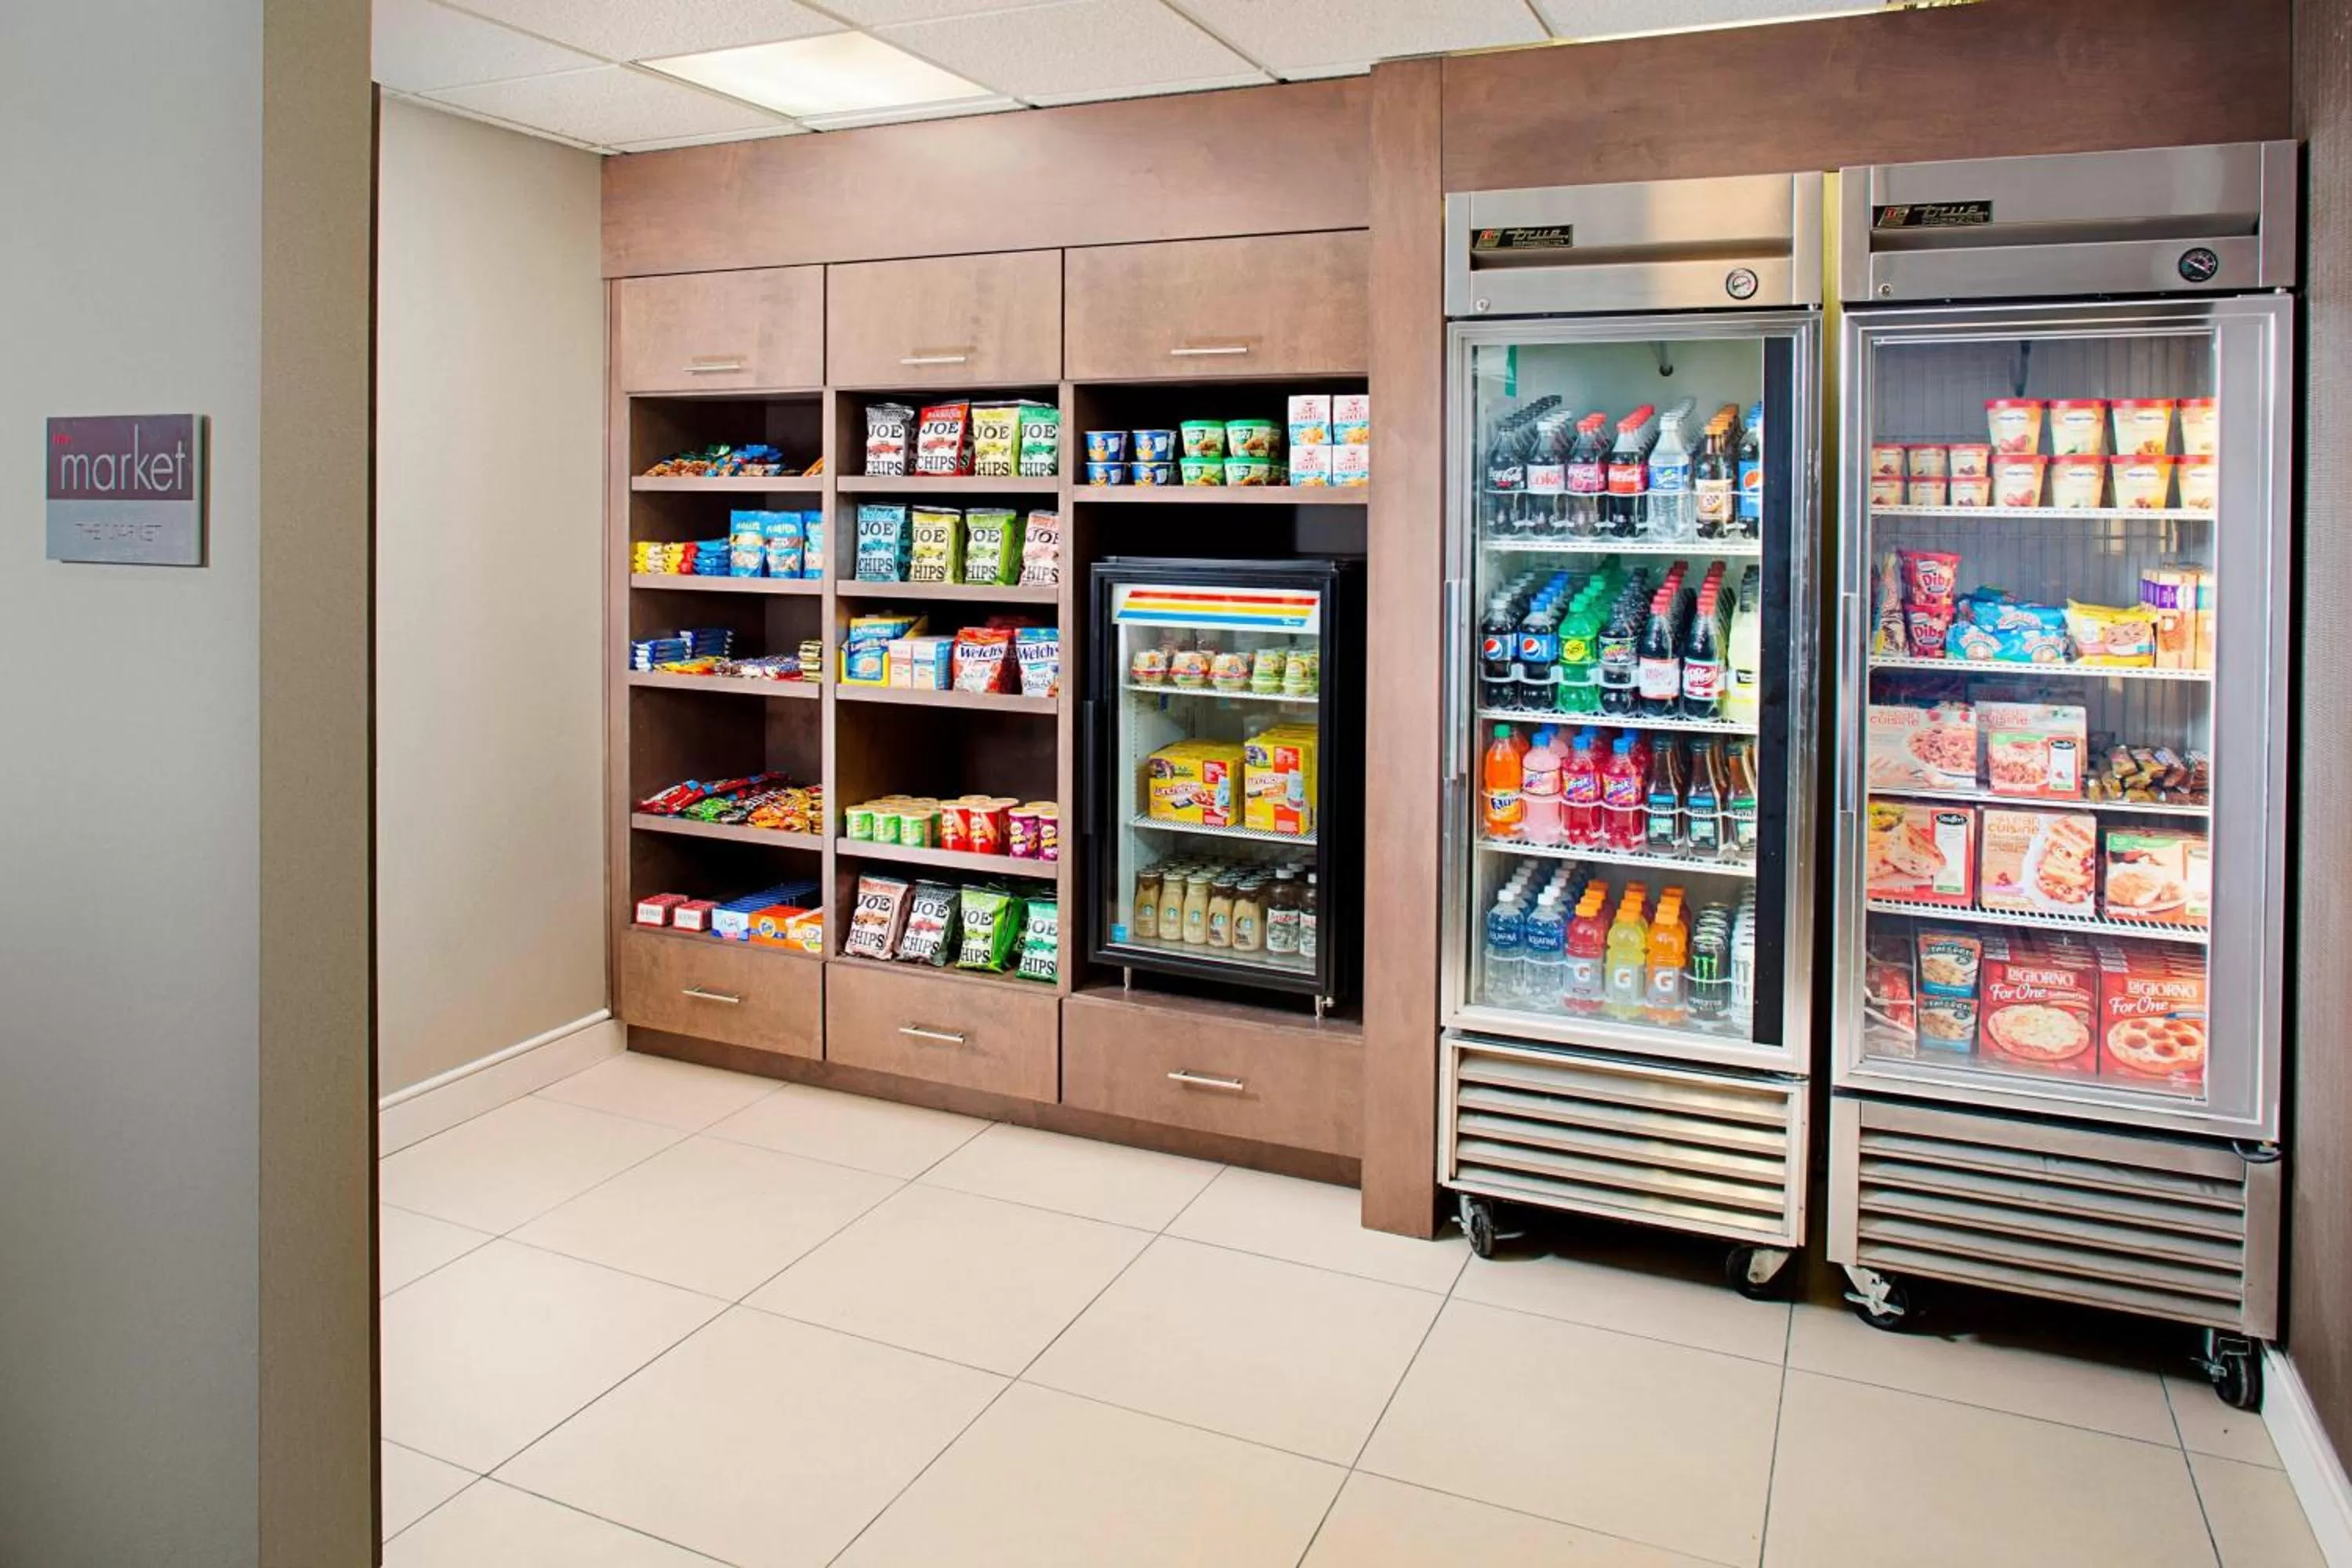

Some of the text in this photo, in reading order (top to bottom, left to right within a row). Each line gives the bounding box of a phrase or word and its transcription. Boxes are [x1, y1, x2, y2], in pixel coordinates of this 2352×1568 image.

[869, 424, 902, 438] JOE
[923, 421, 959, 434] JOE
[975, 425, 1010, 440] JOE
[1022, 424, 1056, 438] JOE
[60, 423, 186, 492] market
[916, 456, 956, 470] CHIPS
[975, 462, 1009, 476] HIPS
[860, 522, 894, 535] JOE
[913, 529, 946, 543] JOE
[973, 529, 1000, 543] OE
[858, 557, 893, 572] CHIPS
[913, 565, 946, 579] HIPS
[966, 564, 997, 579] HIPS
[1026, 565, 1059, 582] HIPS
[1915, 624, 1944, 638] Dibs
[960, 645, 1004, 658] Welch's
[858, 895, 891, 911] JOE
[913, 901, 947, 918] JOE
[1029, 919, 1058, 936] OE
[902, 935, 940, 956] CHIPS
[961, 948, 990, 964] HIPS
[1614, 967, 1632, 988] G
[1655, 971, 1675, 992] G
[1990, 984, 2015, 1001] For
[2016, 983, 2047, 1000] One
[2109, 996, 2169, 1014] For One
